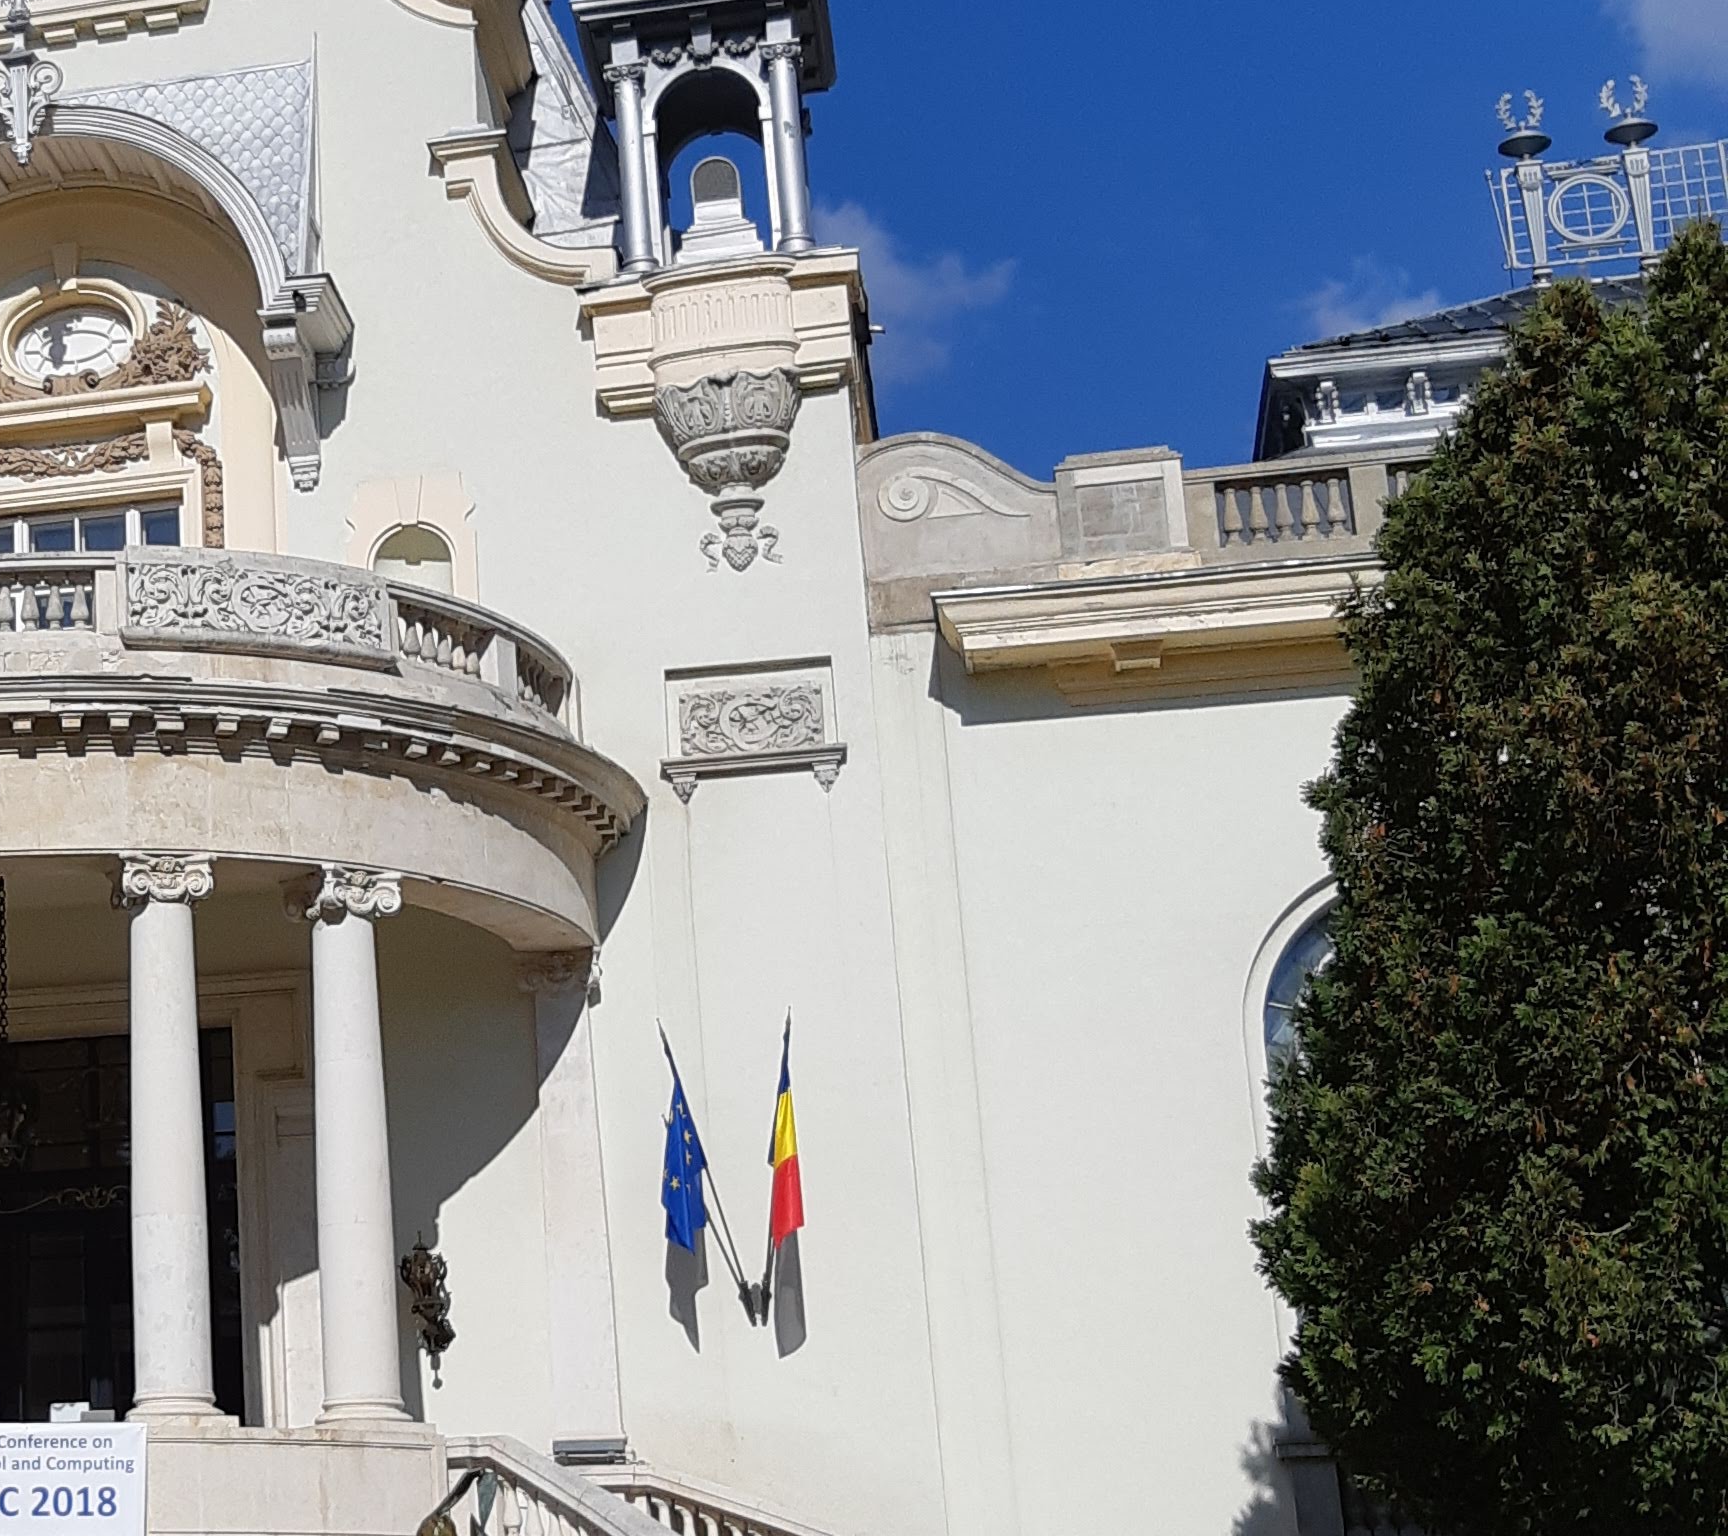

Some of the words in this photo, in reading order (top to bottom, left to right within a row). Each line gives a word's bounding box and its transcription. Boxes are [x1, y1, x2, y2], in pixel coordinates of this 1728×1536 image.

[92, 1437, 113, 1449] on
[11, 1456, 42, 1471] and
[46, 1456, 135, 1474] Computing
[31, 1485, 118, 1517] 2018
